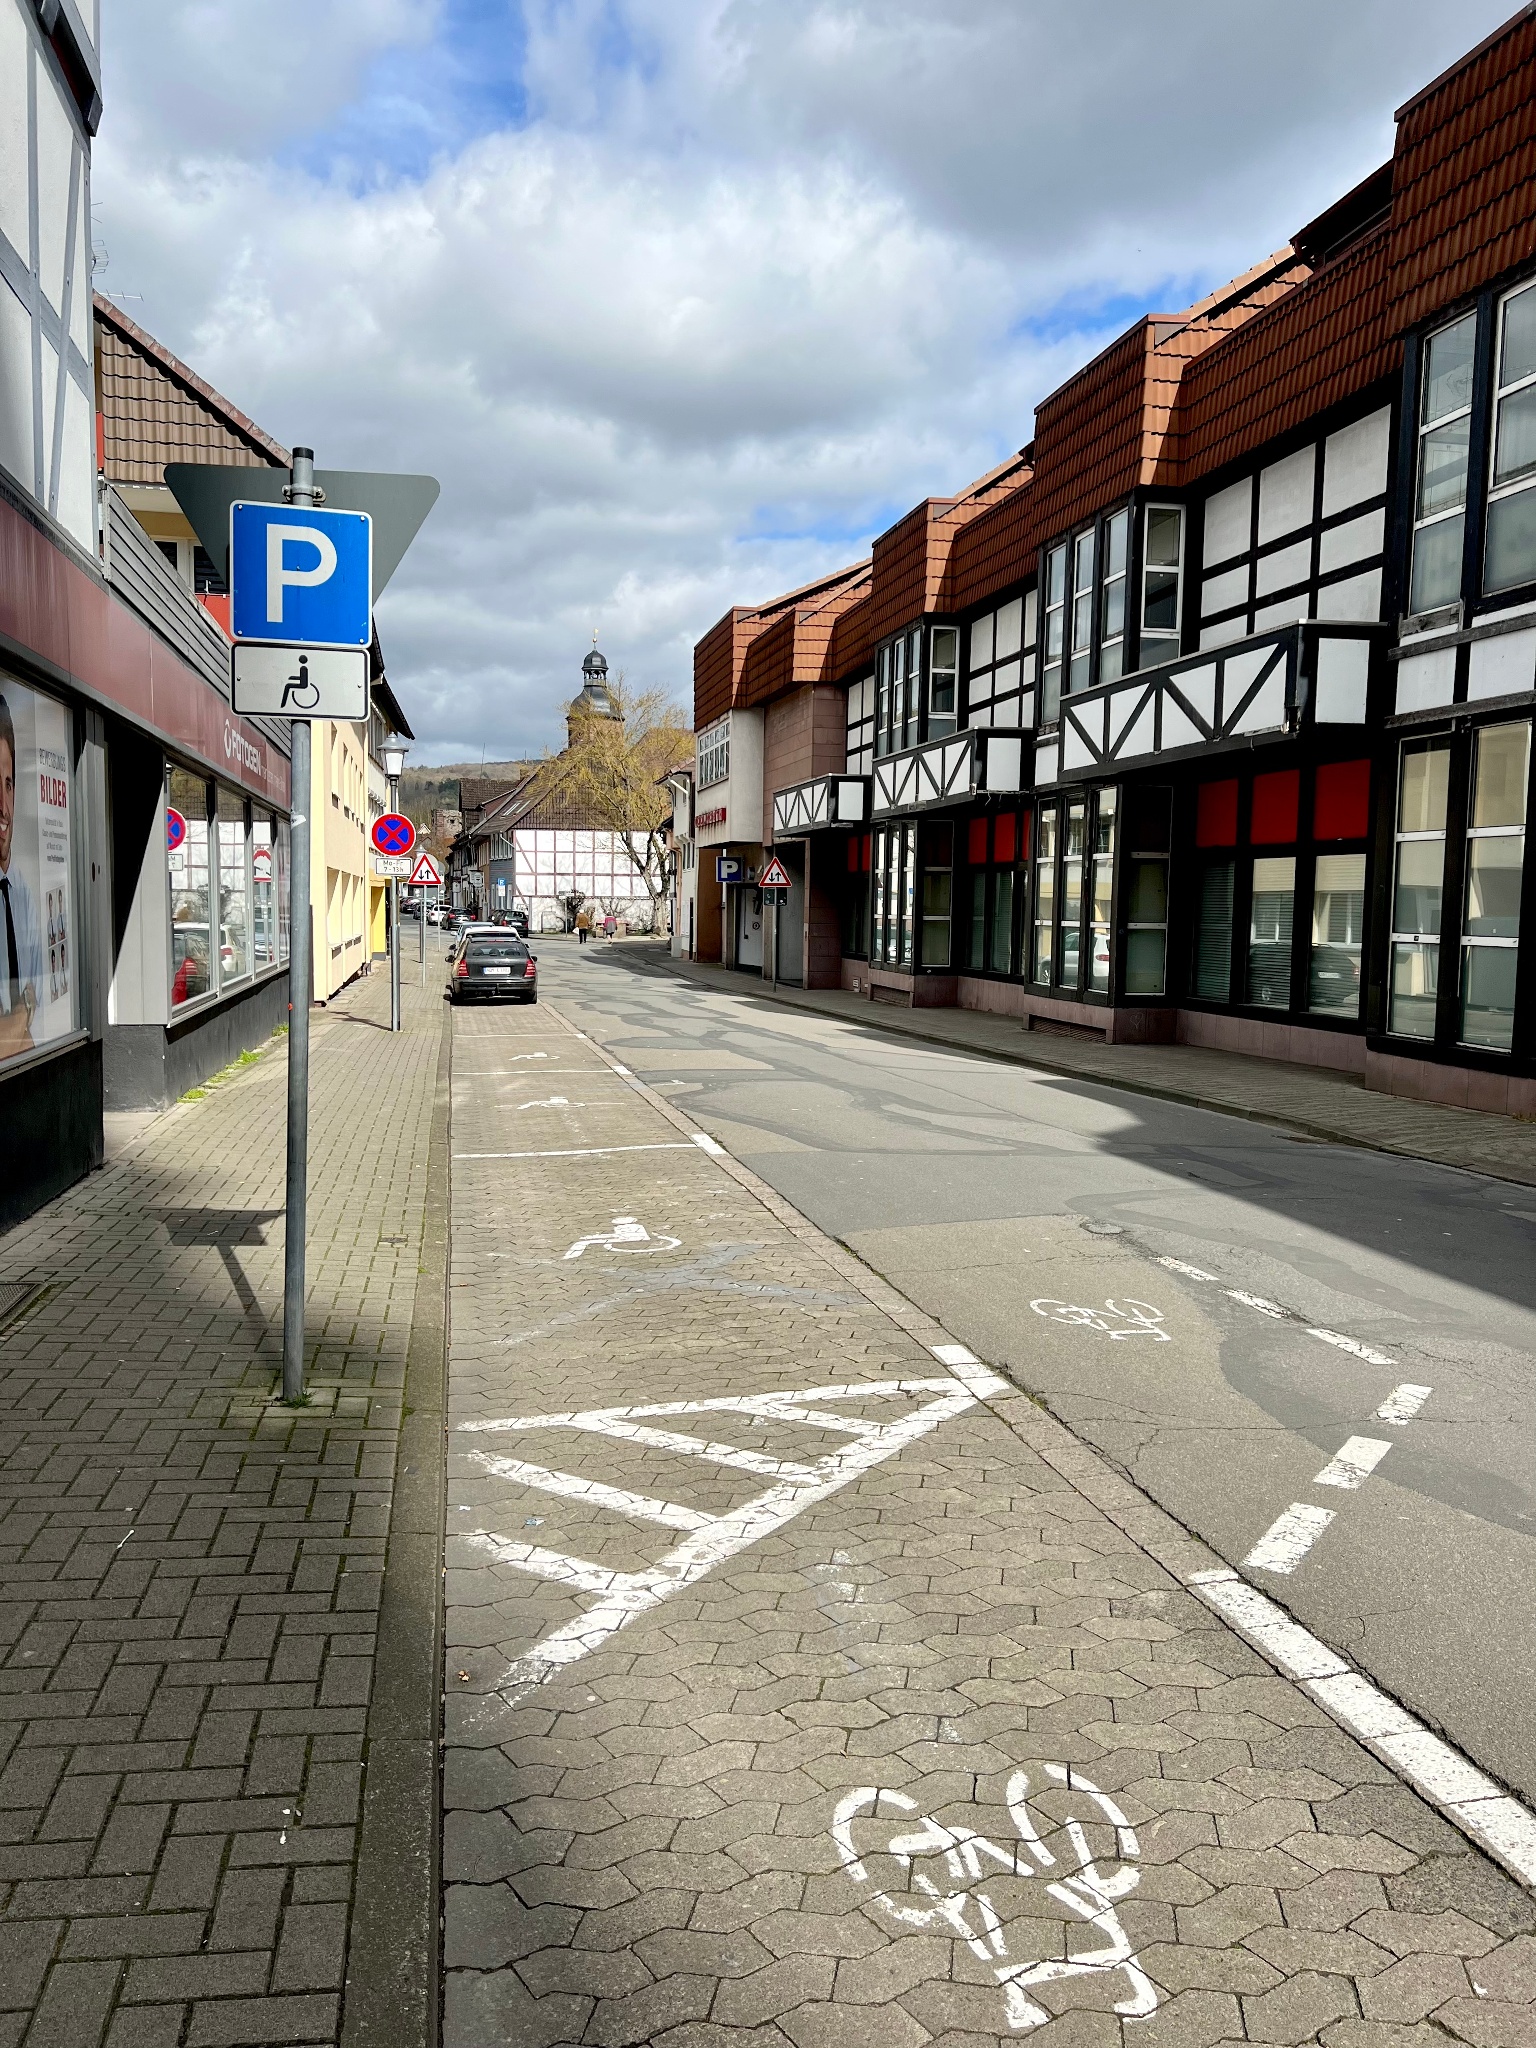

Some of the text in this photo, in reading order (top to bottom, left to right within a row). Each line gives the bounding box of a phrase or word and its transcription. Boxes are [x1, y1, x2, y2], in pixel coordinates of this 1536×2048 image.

[266, 523, 337, 622] P
[231, 729, 262, 776] FOTOGEN
[40, 774, 66, 808] BILDER
[721, 861, 738, 878] P
